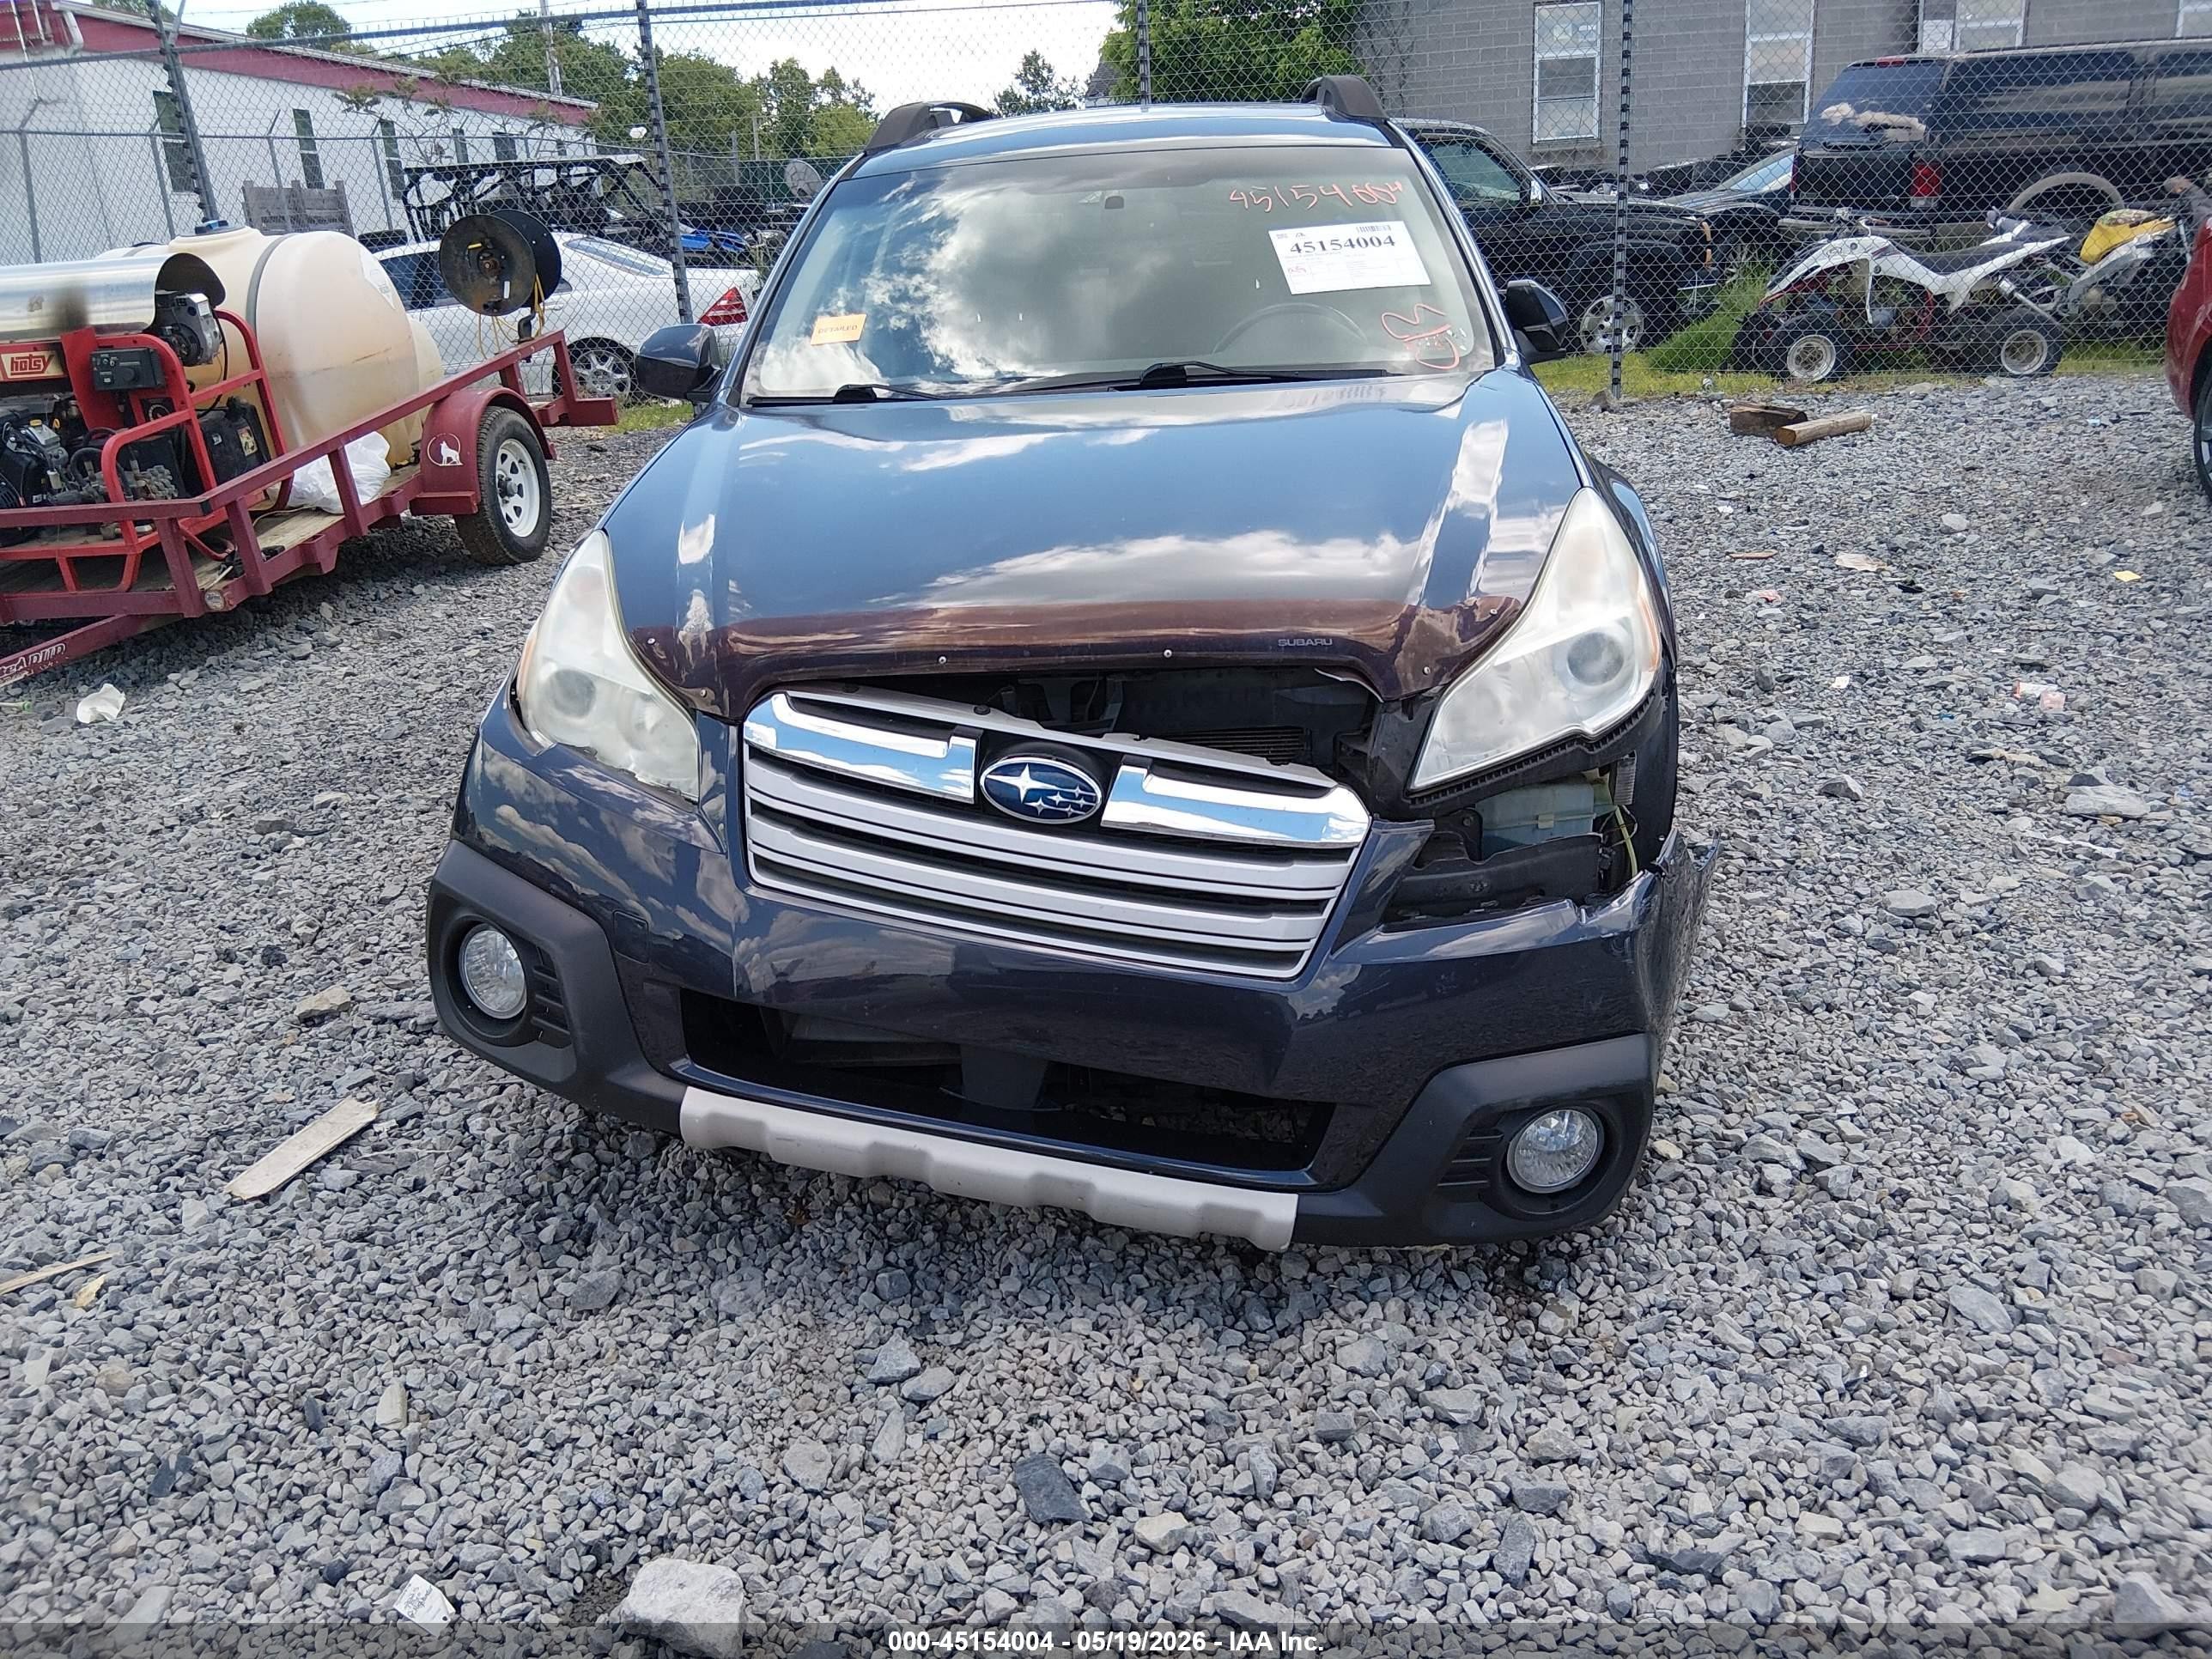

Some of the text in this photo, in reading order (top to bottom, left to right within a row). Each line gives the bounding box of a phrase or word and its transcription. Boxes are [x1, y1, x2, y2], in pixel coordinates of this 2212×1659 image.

[1290, 235, 1395, 254] 45154004
[10, 354, 55, 375] hotsy
[1278, 638, 1333, 647] SUBARU
